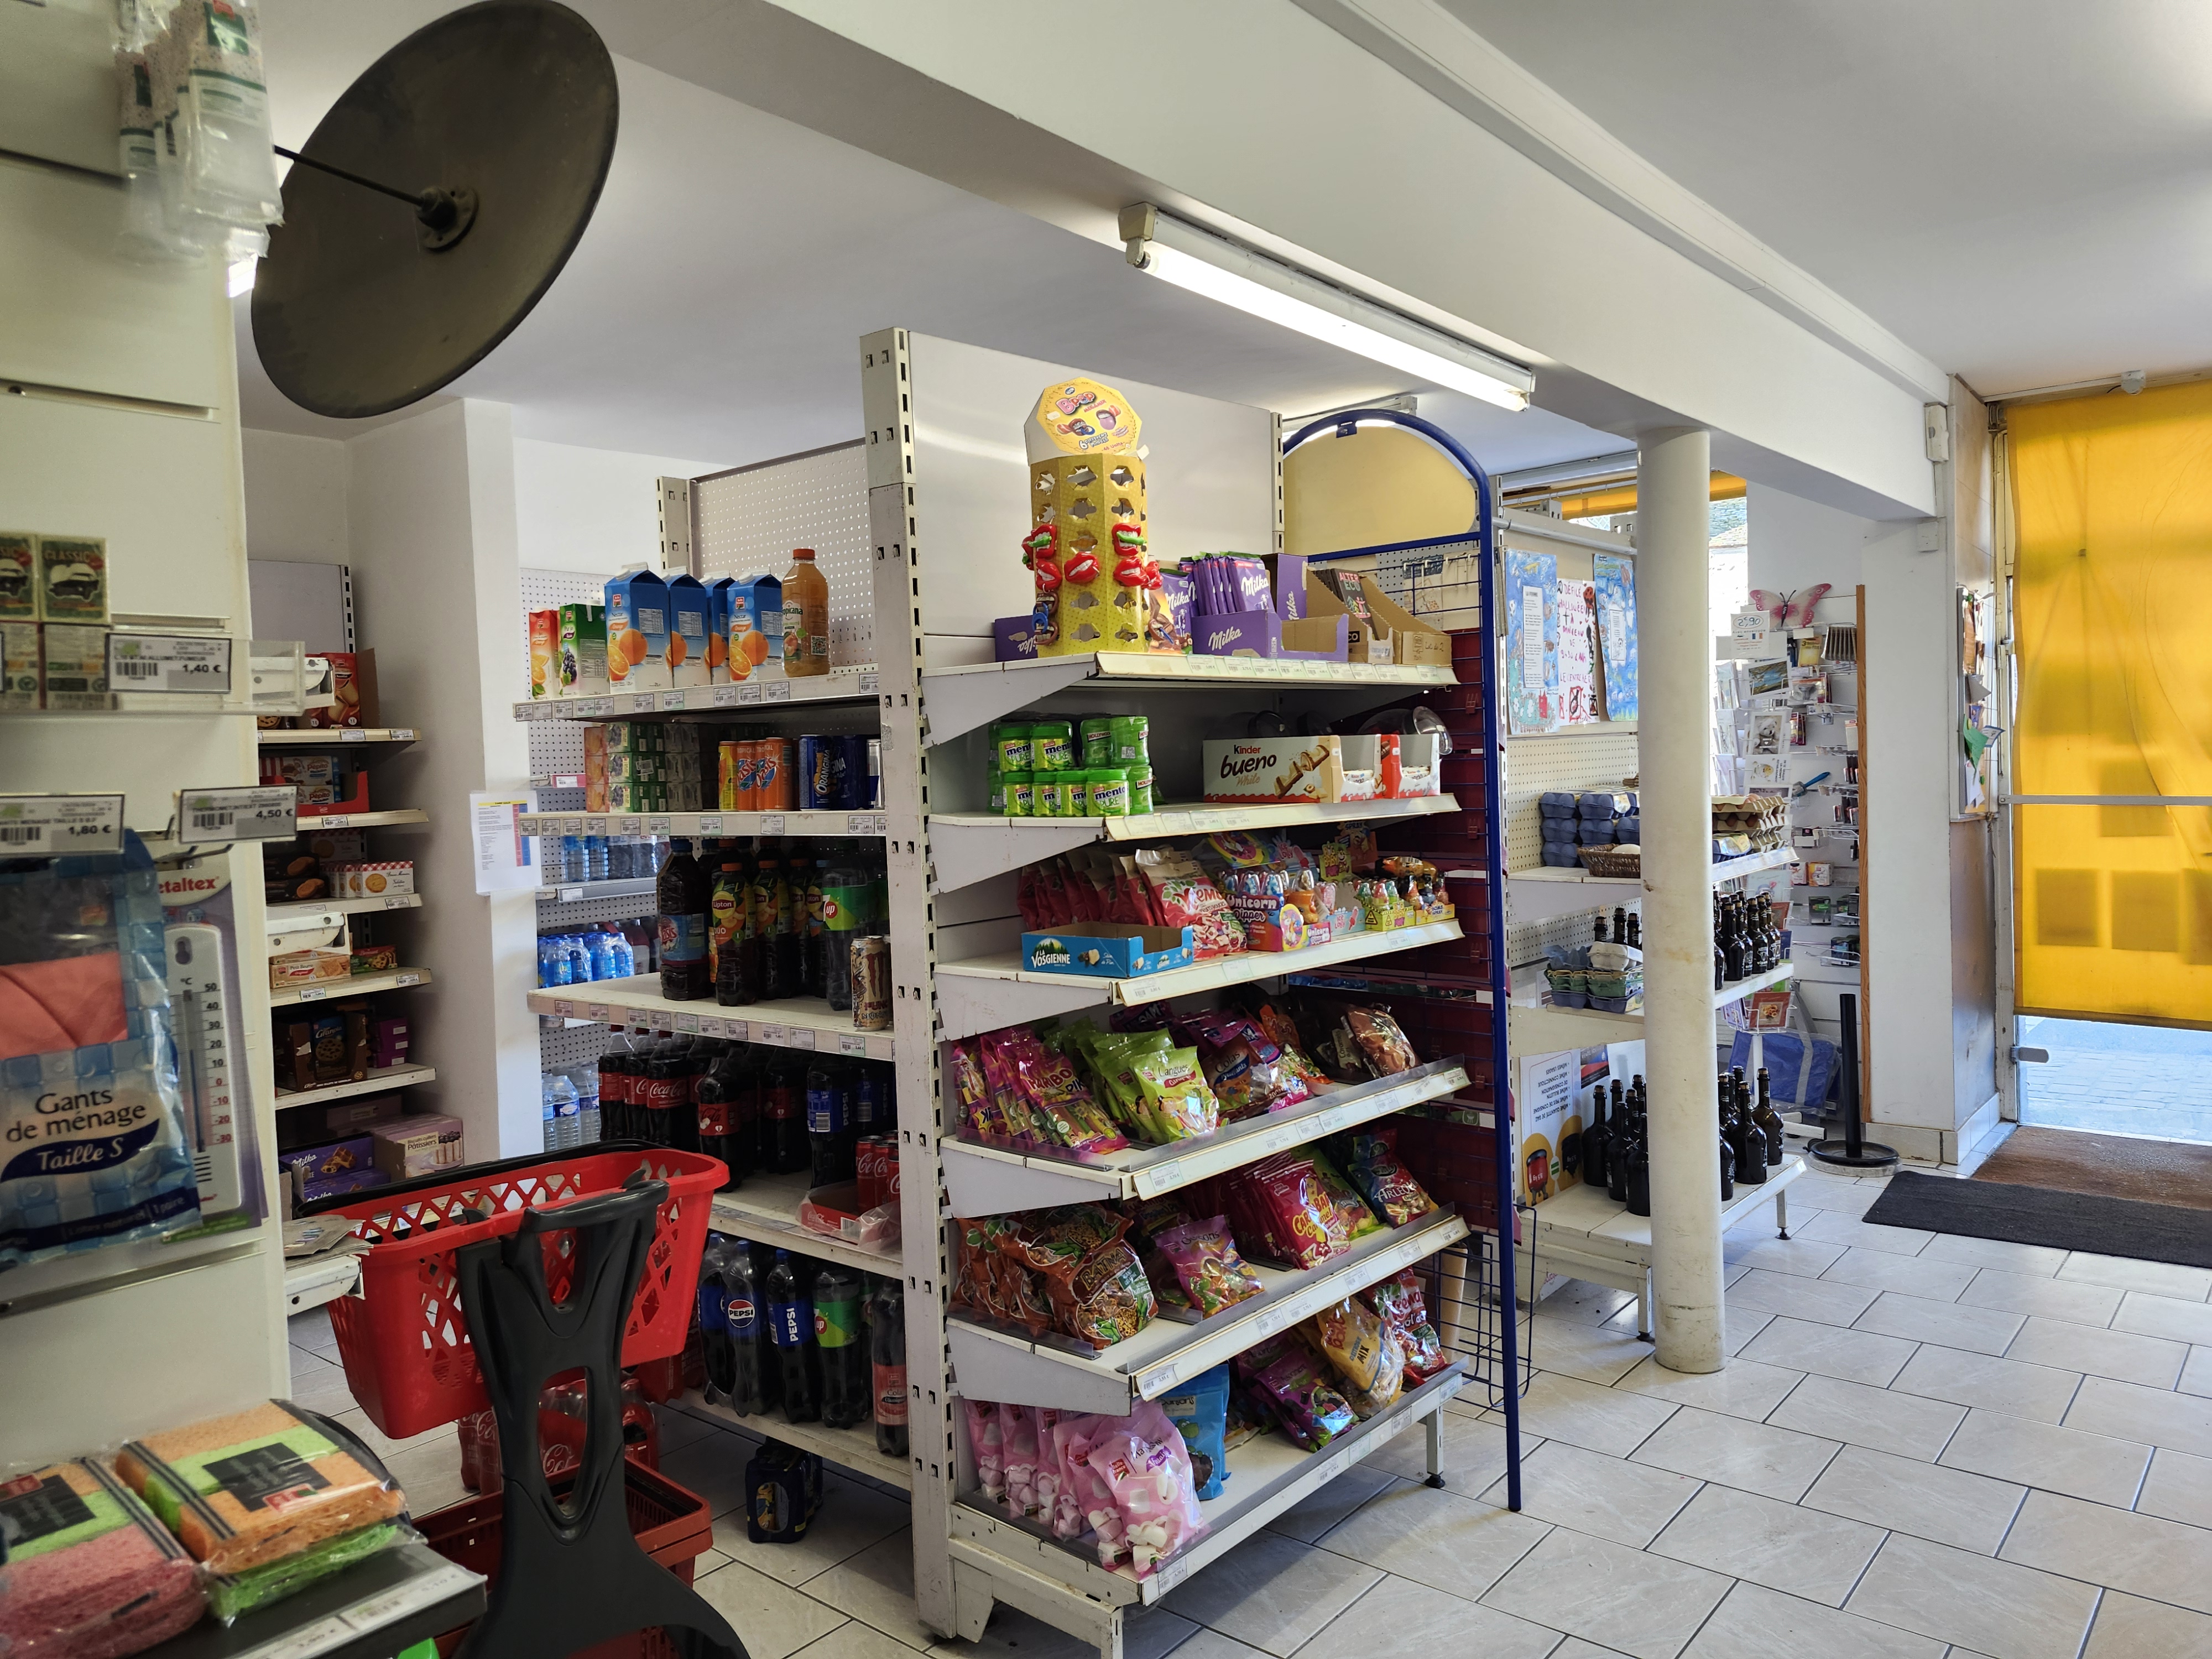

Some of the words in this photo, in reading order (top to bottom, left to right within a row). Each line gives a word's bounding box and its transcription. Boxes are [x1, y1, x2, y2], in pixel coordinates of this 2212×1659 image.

[1084, 399, 1107, 413] MEGAMIX
[1079, 440, 1089, 450] 6
[1338, 571, 1360, 583] ALTER
[1240, 574, 1269, 597] Milka
[1343, 580, 1361, 591] ECO
[1165, 591, 1190, 610] Milka
[1208, 626, 1243, 651] Milka
[182, 664, 209, 675] 1,40
[1088, 731, 1111, 741] HOLLYWOO
[1051, 751, 1068, 762] PURE
[307, 763, 328, 771] Pépito
[1220, 754, 1277, 779] bueno
[1235, 774, 1260, 788] White
[309, 791, 330, 800] Pépito
[1100, 796, 1119, 807] PURE
[256, 808, 282, 820] 4,50
[284, 808, 294, 817] €
[68, 825, 98, 836] 1,80
[102, 824, 112, 834] €
[1323, 854, 1338, 867] BABY
[712, 900, 733, 910] Lipton
[1225, 894, 1277, 910] Unicorn
[1235, 909, 1266, 923] Dipper
[1307, 927, 1329, 936] Unicorn
[1031, 952, 1071, 969] VOSGIENNE
[205, 983, 217, 992] 50
[206, 1001, 219, 1010] 40
[208, 1020, 221, 1029] 30
[210, 1039, 222, 1048] 20
[212, 1058, 224, 1067] 10
[1217, 1052, 1240, 1074] Colas
[1159, 1064, 1190, 1077] Langues
[216, 1077, 223, 1086] 0
[1028, 1068, 1073, 1091] HARIBO
[35, 1088, 113, 1115] Gants
[213, 1095, 229, 1105] -10
[6, 1120, 38, 1143] de
[46, 1104, 148, 1136] ménage
[215, 1114, 230, 1124] -20
[216, 1133, 232, 1143] -30
[408, 1139, 437, 1151] Pâtissiers
[37, 1144, 105, 1172] Taille
[109, 1137, 124, 1157] S
[291, 1154, 317, 1166] Milka
[1374, 1178, 1417, 1202] ARLEQUI
[1081, 1248, 1126, 1290] BATNA
[729, 1309, 754, 1317] PEPSI
[786, 1307, 799, 1342] PEPSI
[1357, 1344, 1370, 1364] MIX
[1111, 1461, 1124, 1469] Belle
[1112, 1465, 1128, 1475] France
